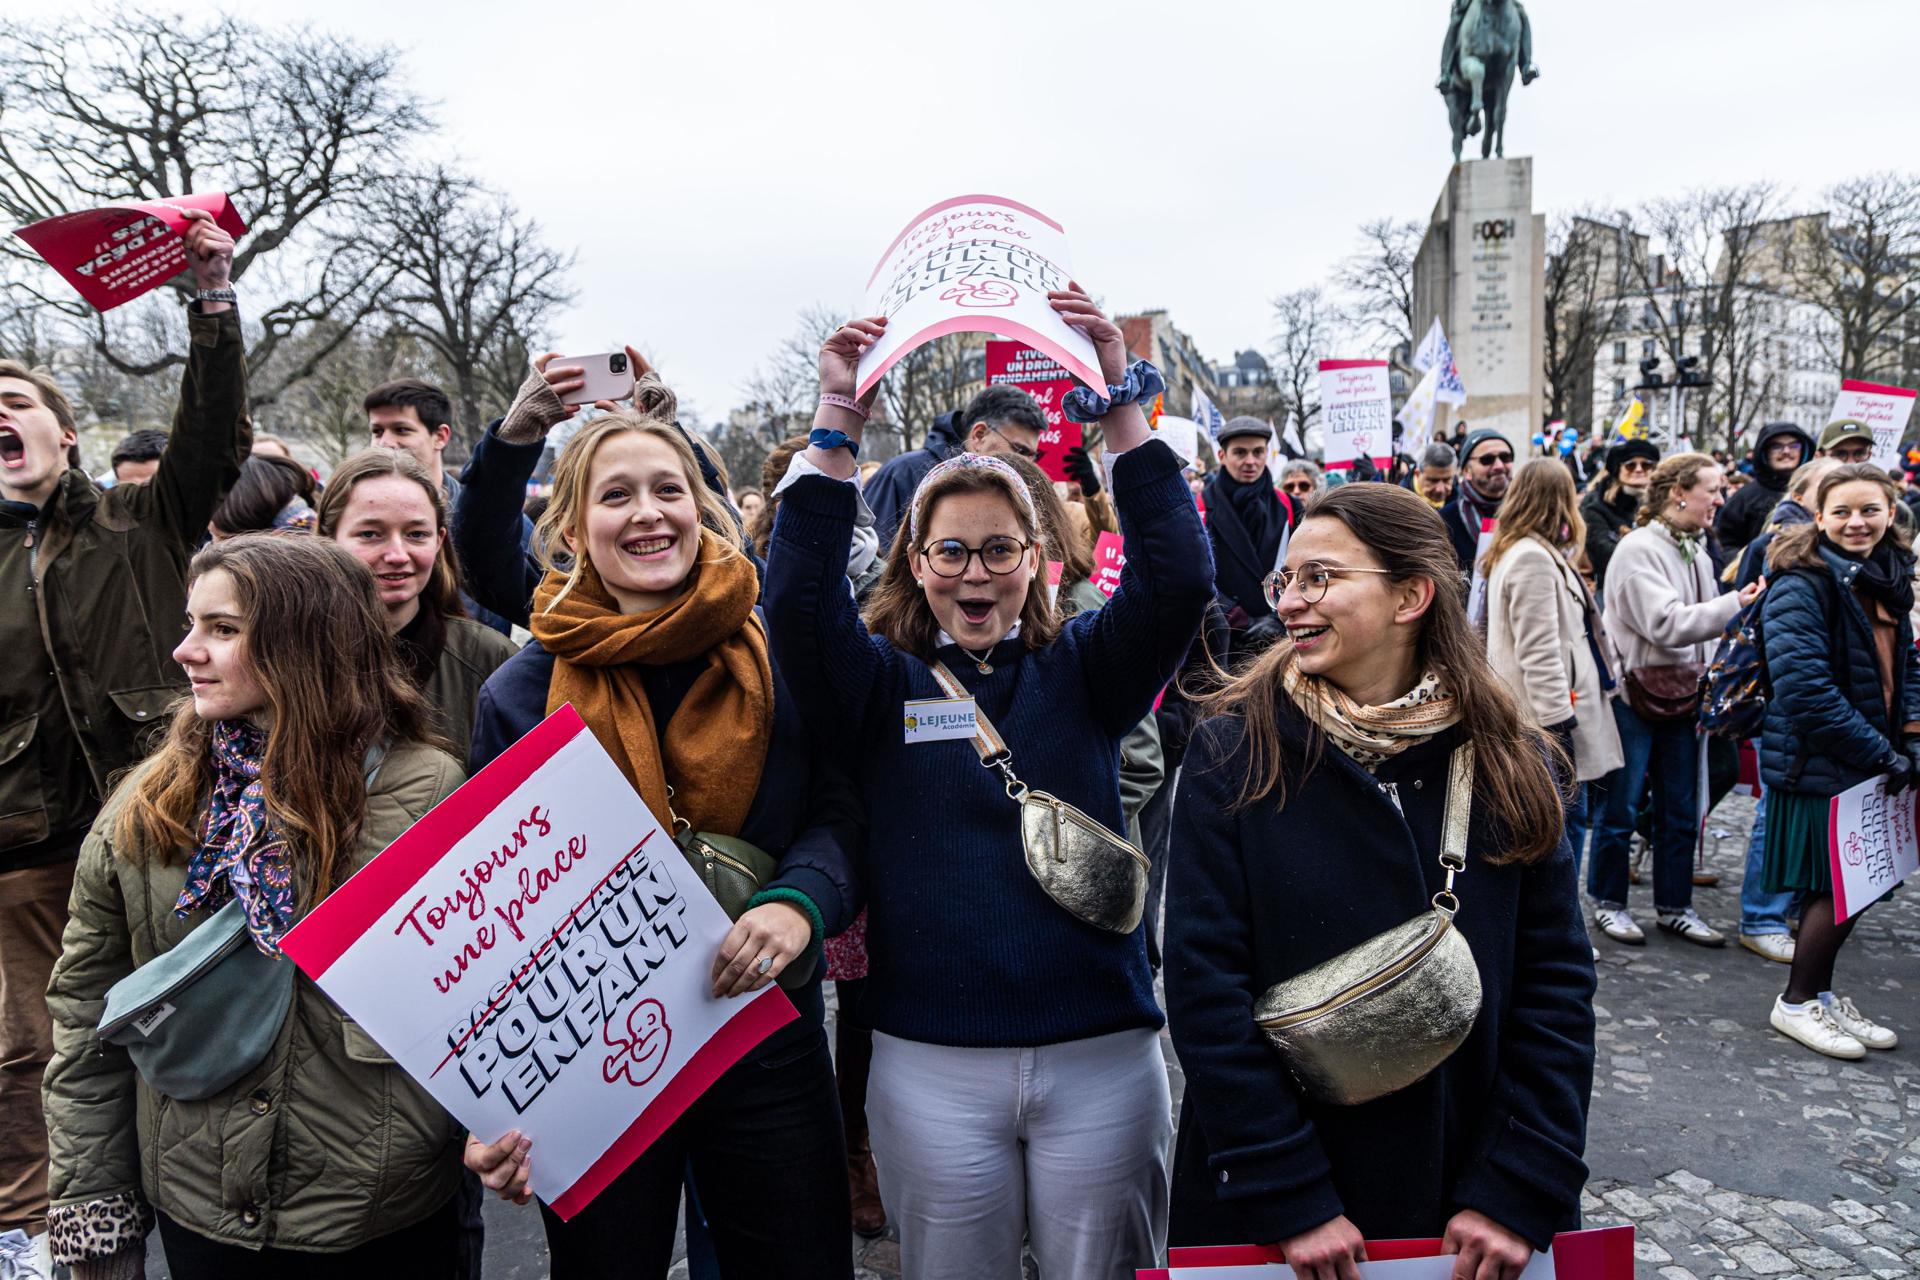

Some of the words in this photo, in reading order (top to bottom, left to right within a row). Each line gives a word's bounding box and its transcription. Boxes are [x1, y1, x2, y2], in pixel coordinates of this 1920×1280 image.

[947, 220, 1032, 240] place
[1472, 218, 1515, 242] FOCH
[128, 263, 169, 289] ceux
[990, 369, 1071, 385] FONDAMENTA
[1006, 361, 1023, 373] UN
[919, 713, 975, 727] LEJEUNE
[1903, 785, 1913, 843] oujours
[394, 804, 552, 946] Toujours
[433, 922, 496, 993] une
[496, 834, 588, 942] place
[446, 980, 514, 1057] PAS
[513, 936, 564, 996] DE
[551, 846, 650, 946] PLACE
[458, 932, 608, 1098] POUR
[600, 859, 678, 950] UN
[500, 902, 688, 1115] ENFANT
